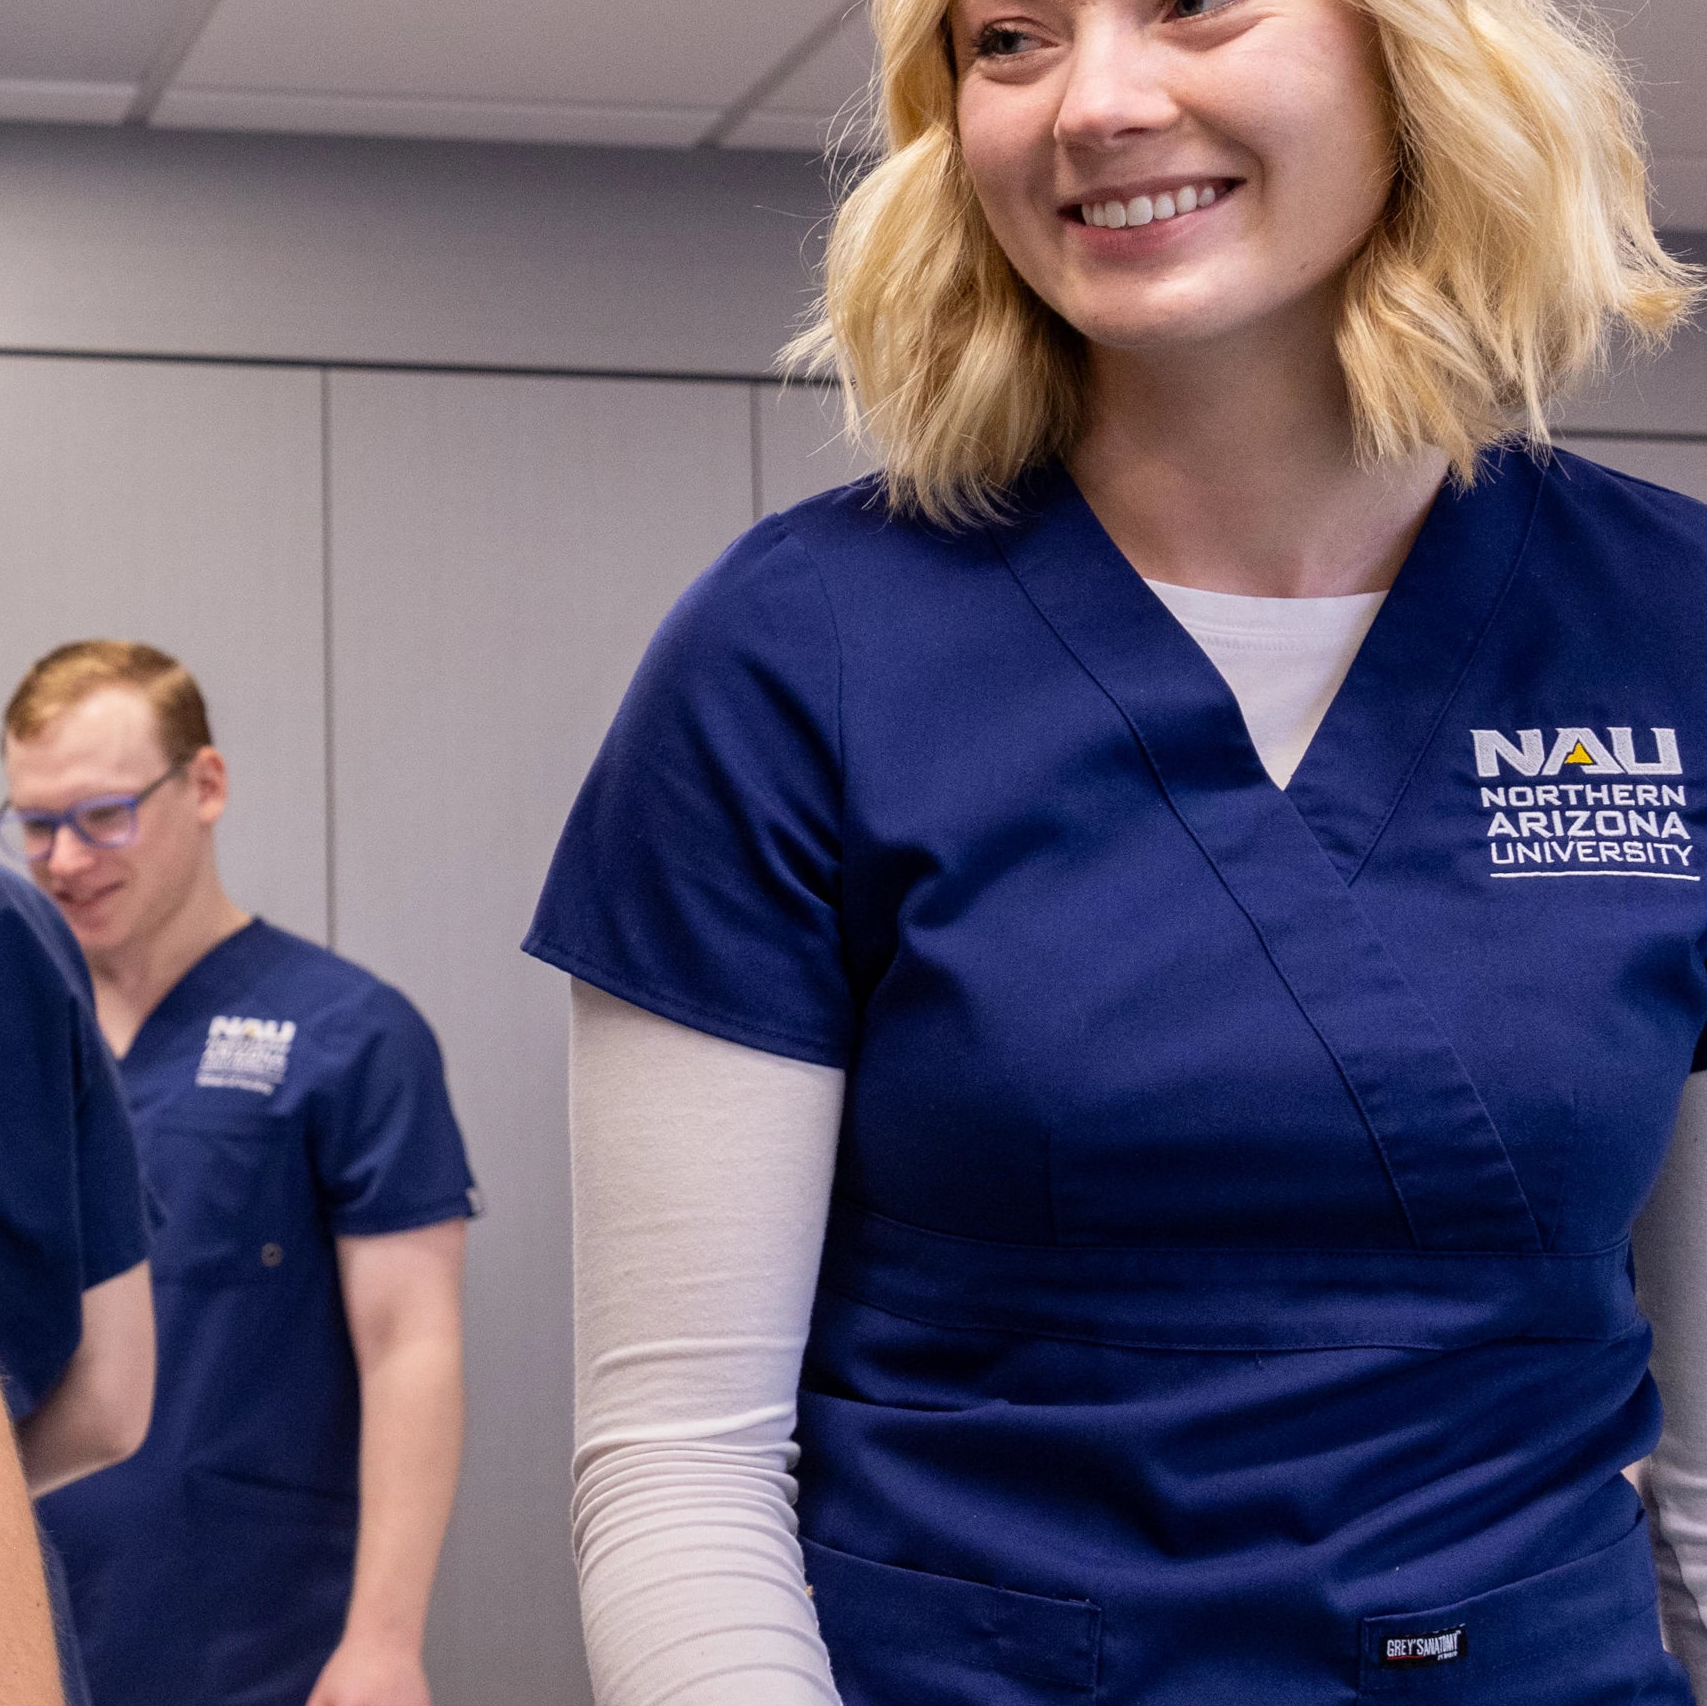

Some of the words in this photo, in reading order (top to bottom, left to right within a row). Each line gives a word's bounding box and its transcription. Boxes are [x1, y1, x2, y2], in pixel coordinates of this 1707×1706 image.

[1469, 727, 1683, 777] NAU
[1480, 784, 1687, 808] NORTHERN
[1487, 810, 1691, 839] ARIZONA
[1490, 841, 1694, 866] UNIVERSITY
